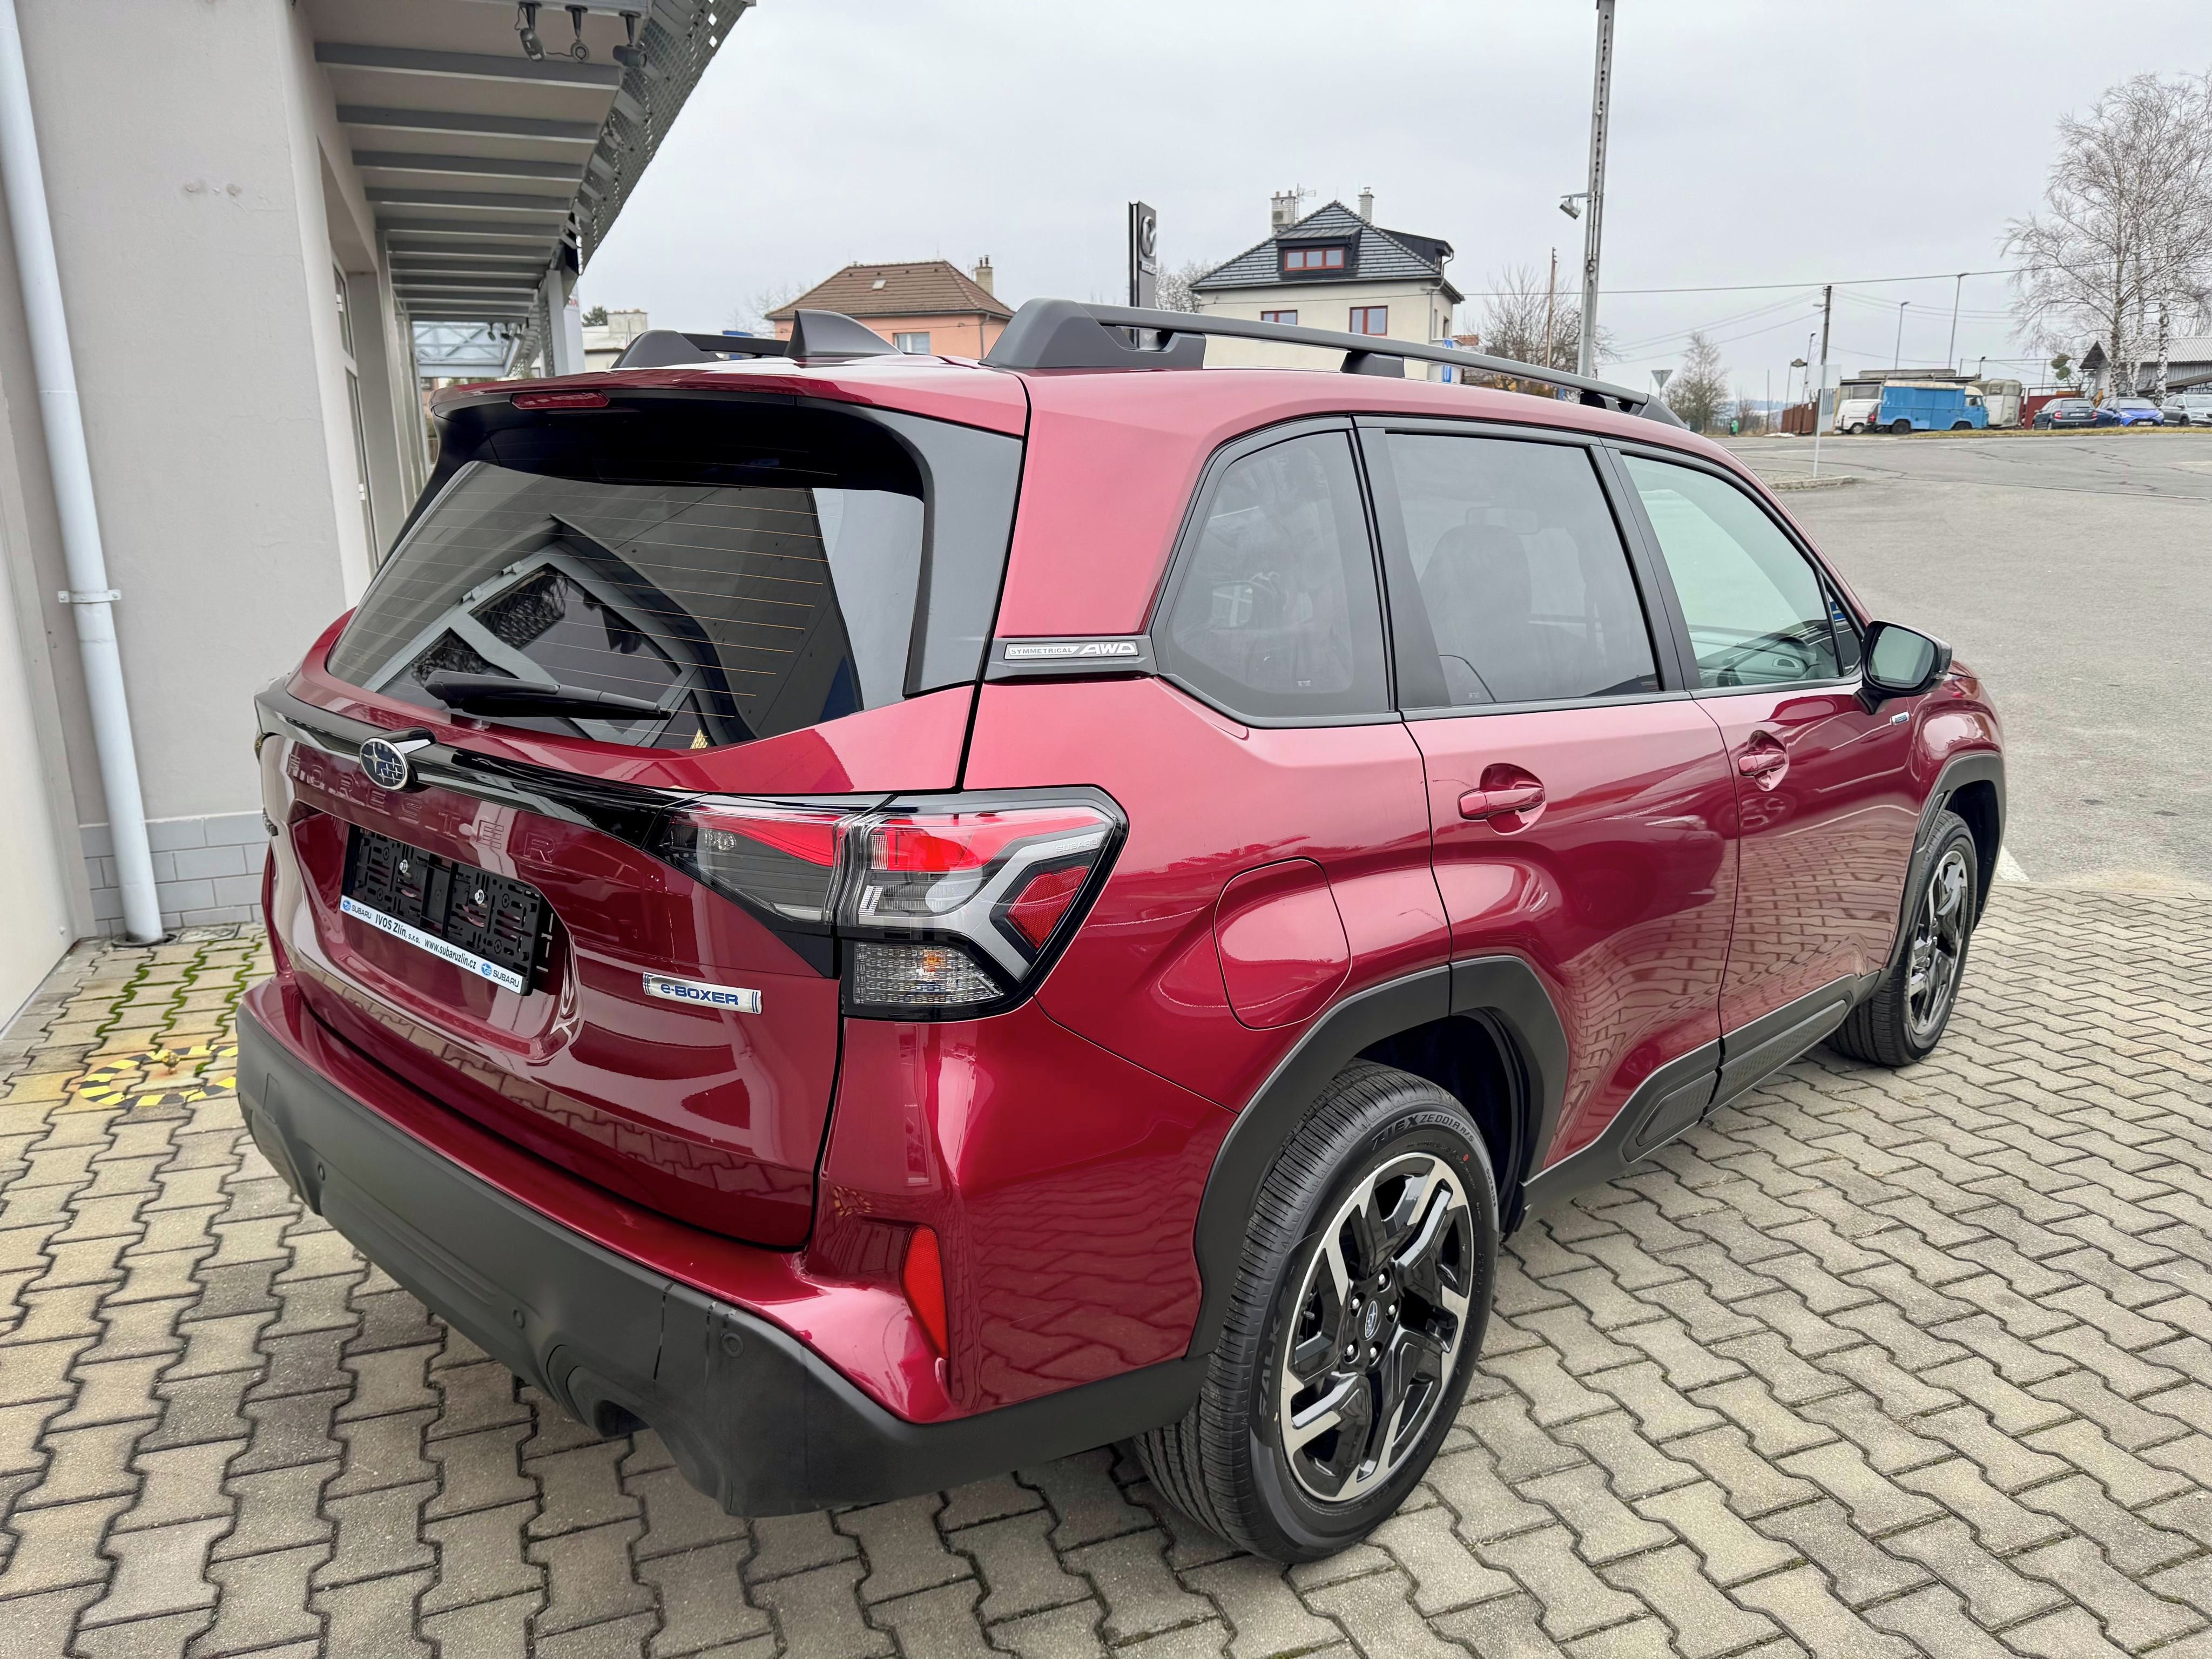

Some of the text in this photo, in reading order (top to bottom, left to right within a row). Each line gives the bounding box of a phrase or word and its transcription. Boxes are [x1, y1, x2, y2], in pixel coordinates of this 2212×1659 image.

[1079, 643, 1136, 655] AWD
[1055, 838, 1098, 853] SUBARU
[352, 905, 372, 919] SUBARU
[375, 914, 392, 930] IVOS
[408, 933, 420, 944] s.r.o.
[424, 939, 477, 969] www.subaruzlin.cz
[493, 970, 520, 988] SUBARU
[660, 983, 739, 1006] e-BOXER
